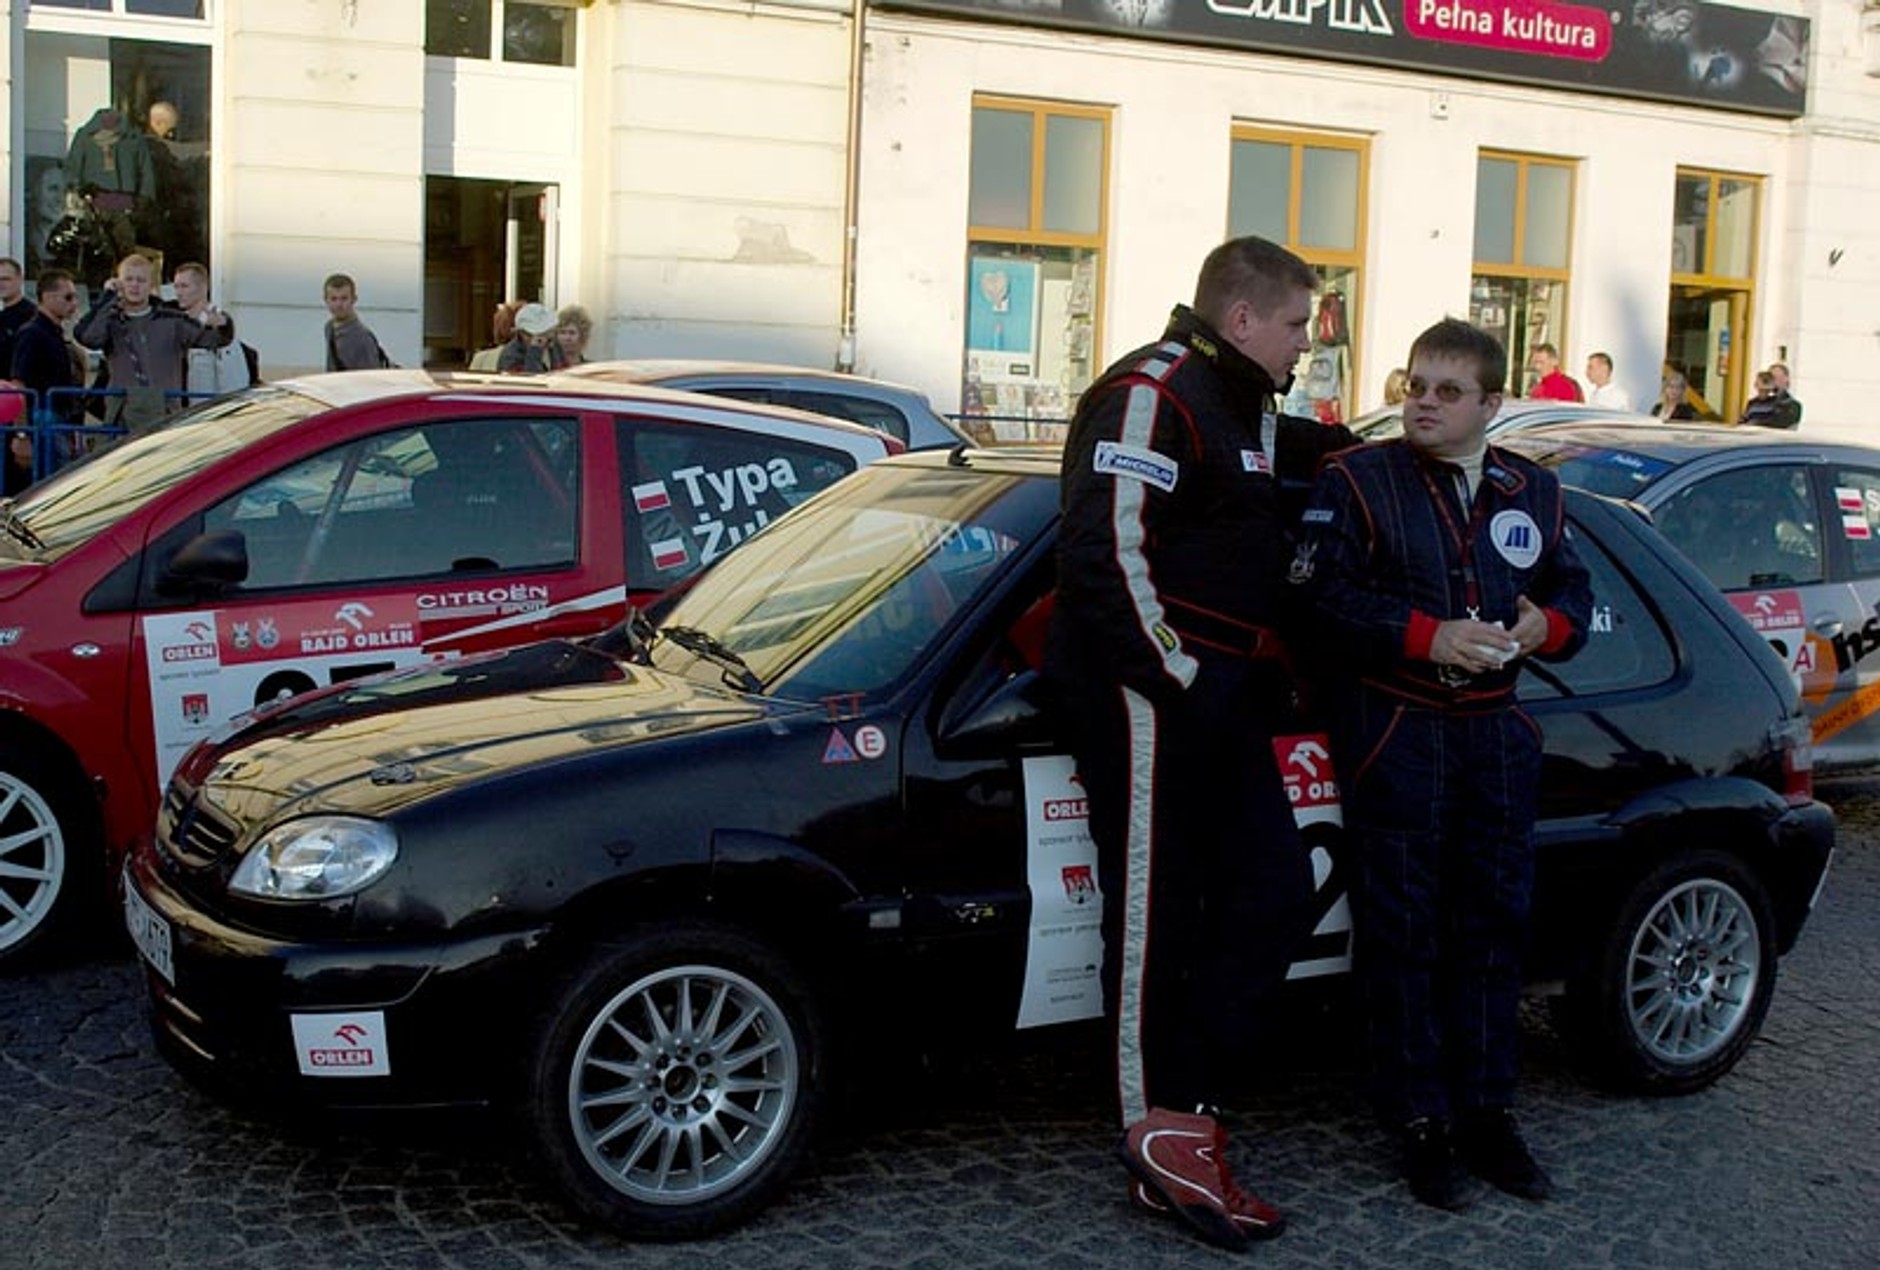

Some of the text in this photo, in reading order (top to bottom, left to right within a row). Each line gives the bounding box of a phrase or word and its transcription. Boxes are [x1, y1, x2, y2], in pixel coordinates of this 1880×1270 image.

[1419, 0, 1597, 49] Pełna kultura
[672, 457, 798, 512] Typa
[416, 584, 548, 608] CITROËN
[301, 635, 348, 653] RAJD
[354, 628, 415, 647] ORLEN
[164, 645, 214, 661] ORLEN
[1793, 644, 1813, 672] A
[862, 731, 880, 752] E
[313, 1050, 369, 1065] ORLEN
